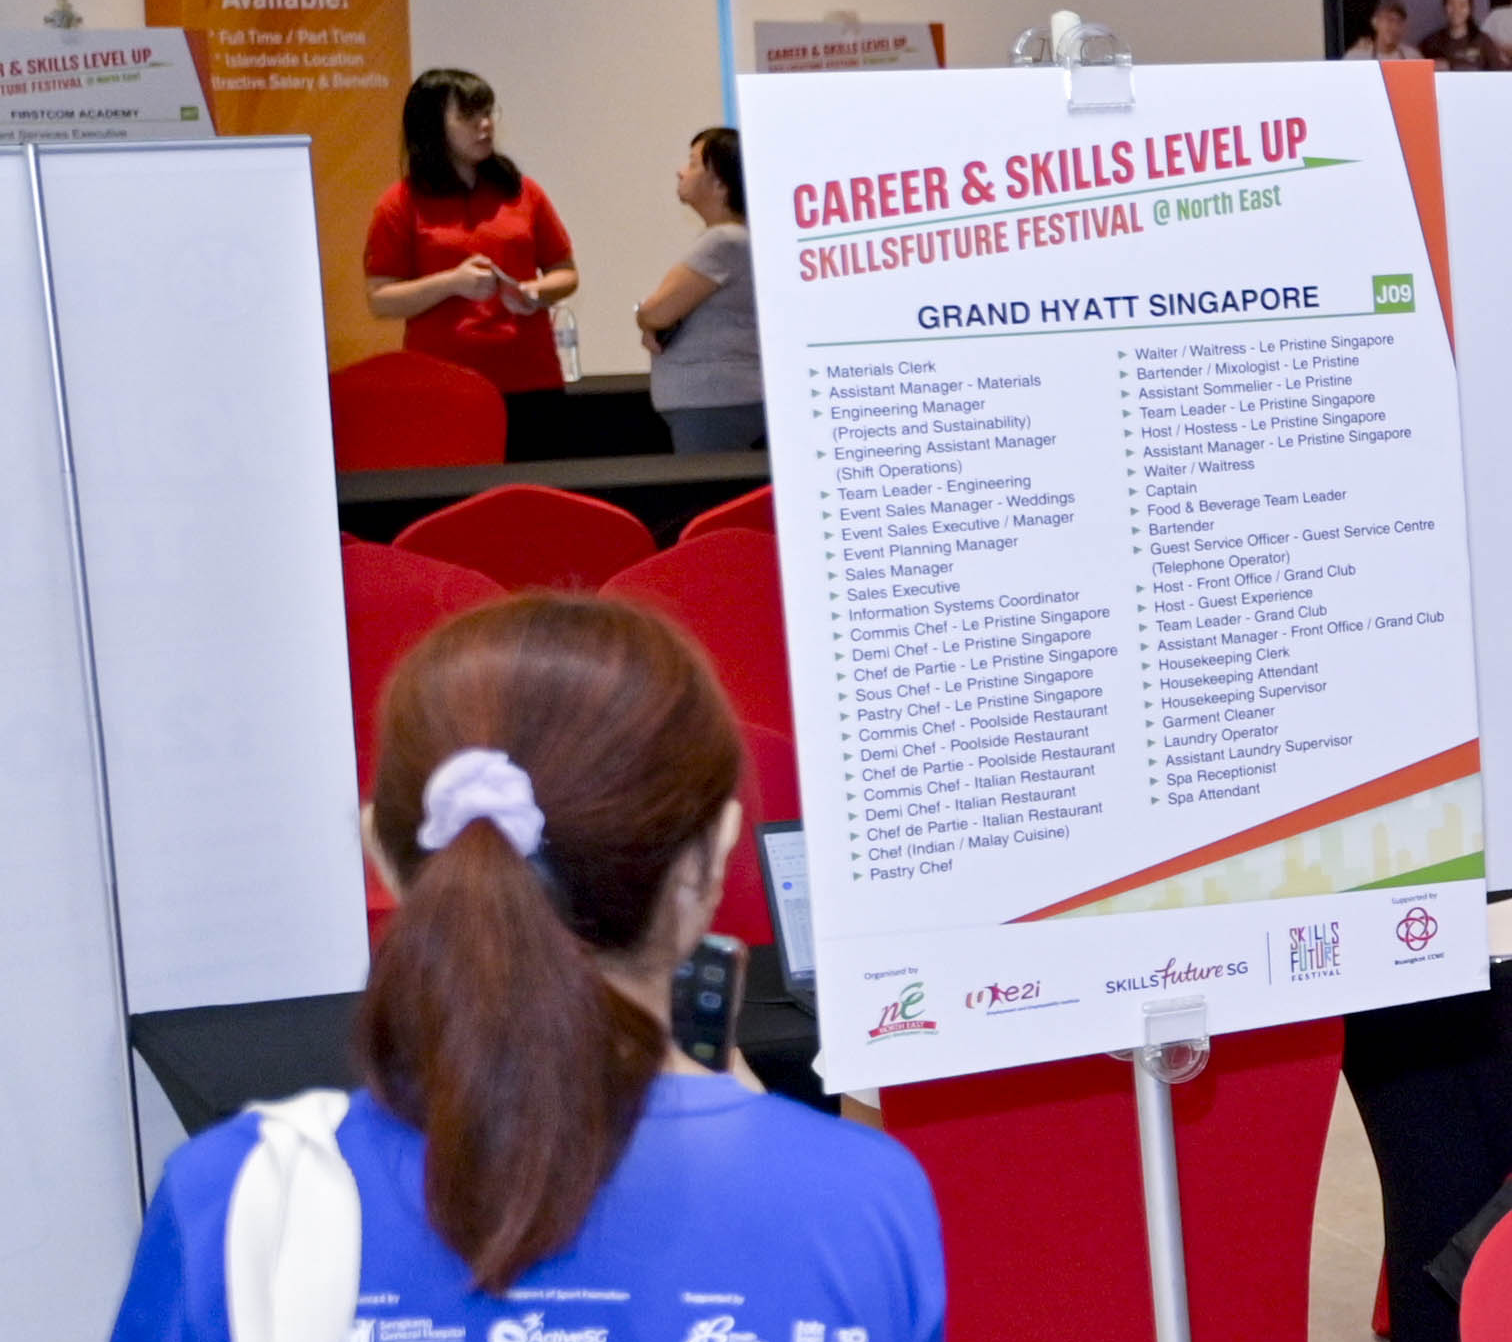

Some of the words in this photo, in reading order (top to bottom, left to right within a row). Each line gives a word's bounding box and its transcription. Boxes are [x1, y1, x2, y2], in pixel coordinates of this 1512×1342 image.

[9, 60, 23, 77] &
[27, 55, 80, 76] SKILLS
[83, 50, 127, 69] LEVEL
[131, 48, 152, 66] UP
[79, 109, 138, 119] ACADEMY
[793, 166, 949, 229] CAREER
[961, 160, 995, 205] &
[1005, 140, 1134, 199] SKILLS
[1145, 125, 1251, 179] LEVEL
[1260, 117, 1307, 162] UP
[1153, 199, 1170, 226] @
[1176, 191, 1233, 221] North
[1238, 185, 1281, 211] East
[799, 221, 1009, 281] SKILLSFUTURE
[1016, 202, 1144, 250] FESTIVAL
[918, 301, 1030, 329] GRAND
[1040, 295, 1139, 322] HYATT
[1149, 285, 1319, 317] SINGAPORE
[1376, 283, 1413, 307] J09
[826, 363, 894, 378] Materials
[898, 360, 936, 375] Clerk
[832, 425, 897, 442] (Projects
[901, 421, 928, 435] and
[932, 415, 1031, 433] Sustainability)
[1147, 502, 1180, 516] Food
[1184, 500, 1194, 513] &
[1198, 498, 1260, 512] Beverage
[1263, 493, 1299, 506] Team
[1302, 489, 1346, 503] Leader
[1148, 519, 1214, 536] Bartender
[1151, 559, 1224, 576] (Telephone
[1228, 551, 1290, 569] Operator)
[1161, 690, 1254, 709] Housekeeping
[1258, 682, 1327, 699] Supervisor
[1166, 772, 1192, 787] Spa
[1197, 762, 1276, 781] Receptionist
[870, 866, 915, 880] Pastry
[919, 858, 952, 875] Chef
[1289, 921, 1340, 951] SKILLS
[1290, 941, 1341, 973] FUTURE
[1291, 969, 1342, 982] FESTIVAL
